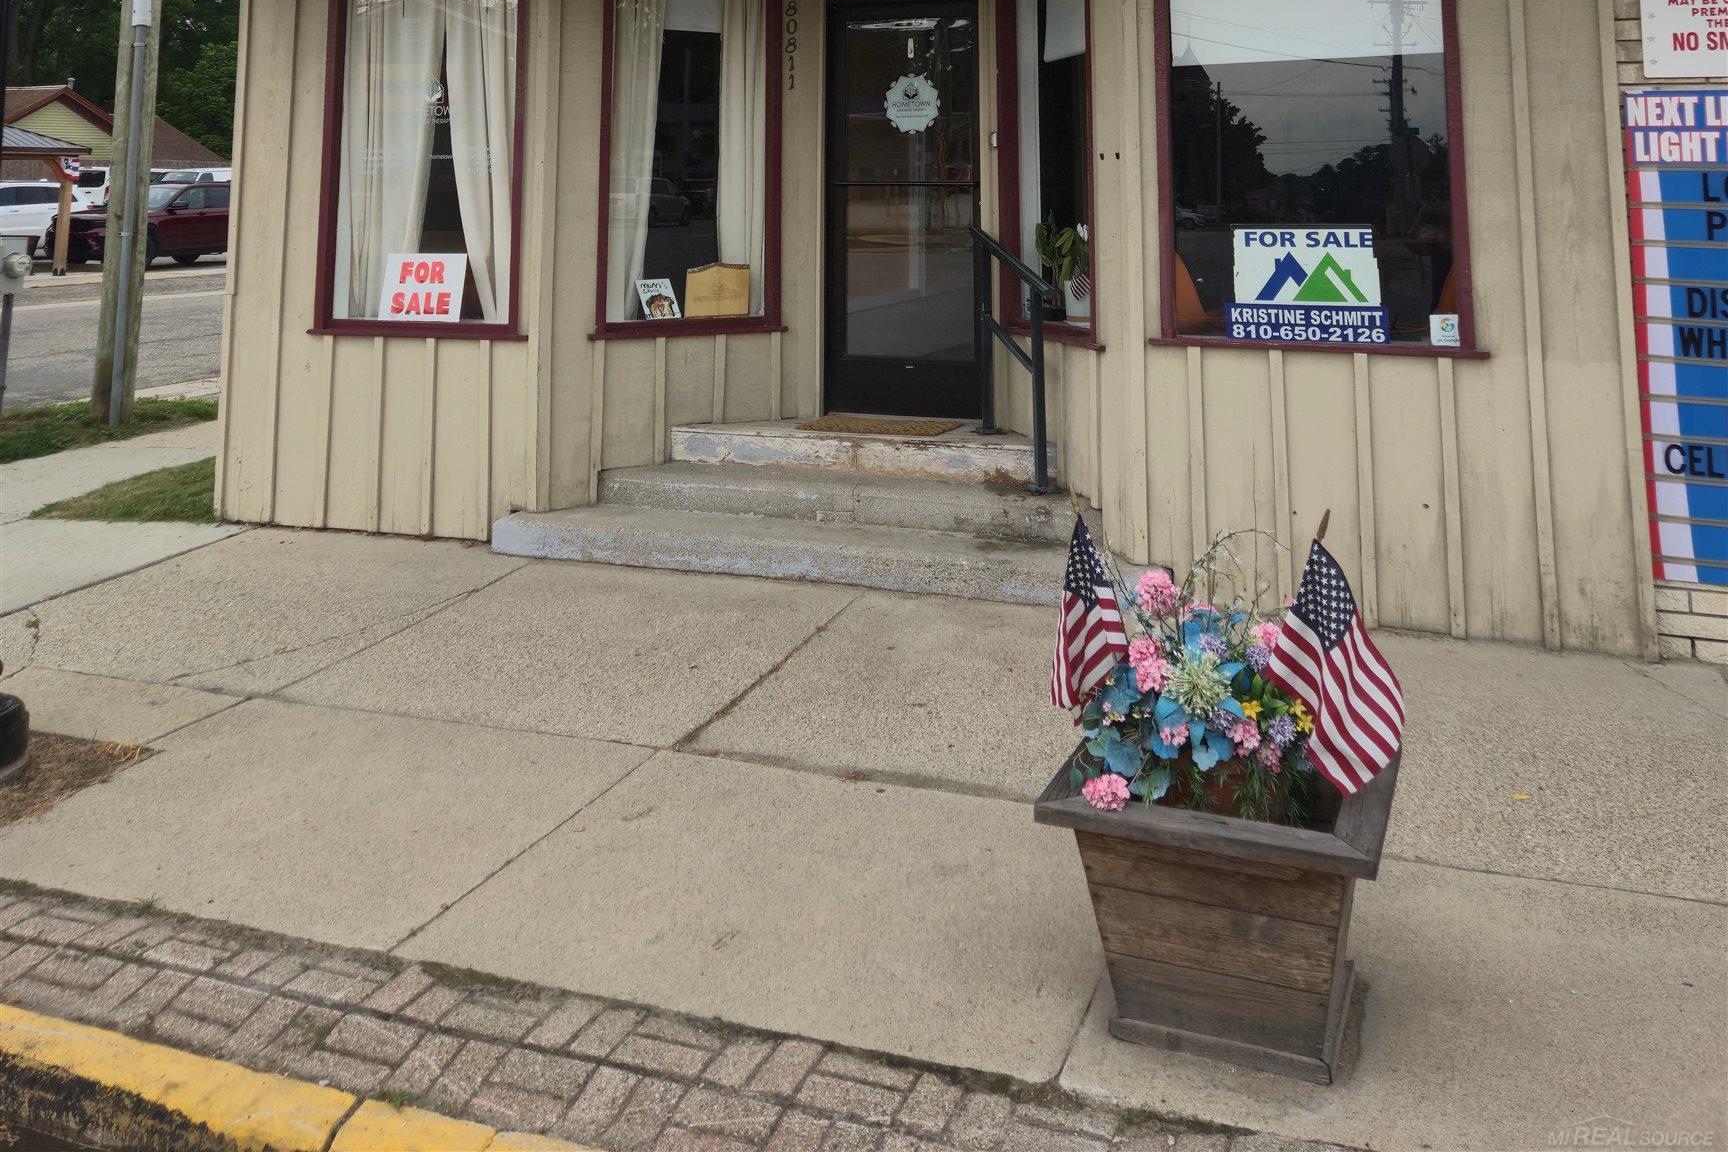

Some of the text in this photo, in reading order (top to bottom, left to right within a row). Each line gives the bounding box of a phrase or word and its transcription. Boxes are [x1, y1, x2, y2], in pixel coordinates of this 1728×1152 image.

[785, 0, 797, 90] 80811
[1672, 31, 1700, 51] NO
[891, 100, 931, 108] HOMETOWN
[1627, 96, 1698, 126] NEXT
[1634, 131, 1720, 162] LIGHT
[1244, 232, 1373, 248] FOR SALE
[399, 261, 445, 284] FOR
[390, 291, 452, 315] SALE
[1231, 308, 1383, 326] KRISTINE SCHMITT
[1232, 324, 1386, 343] 810-650-2126
